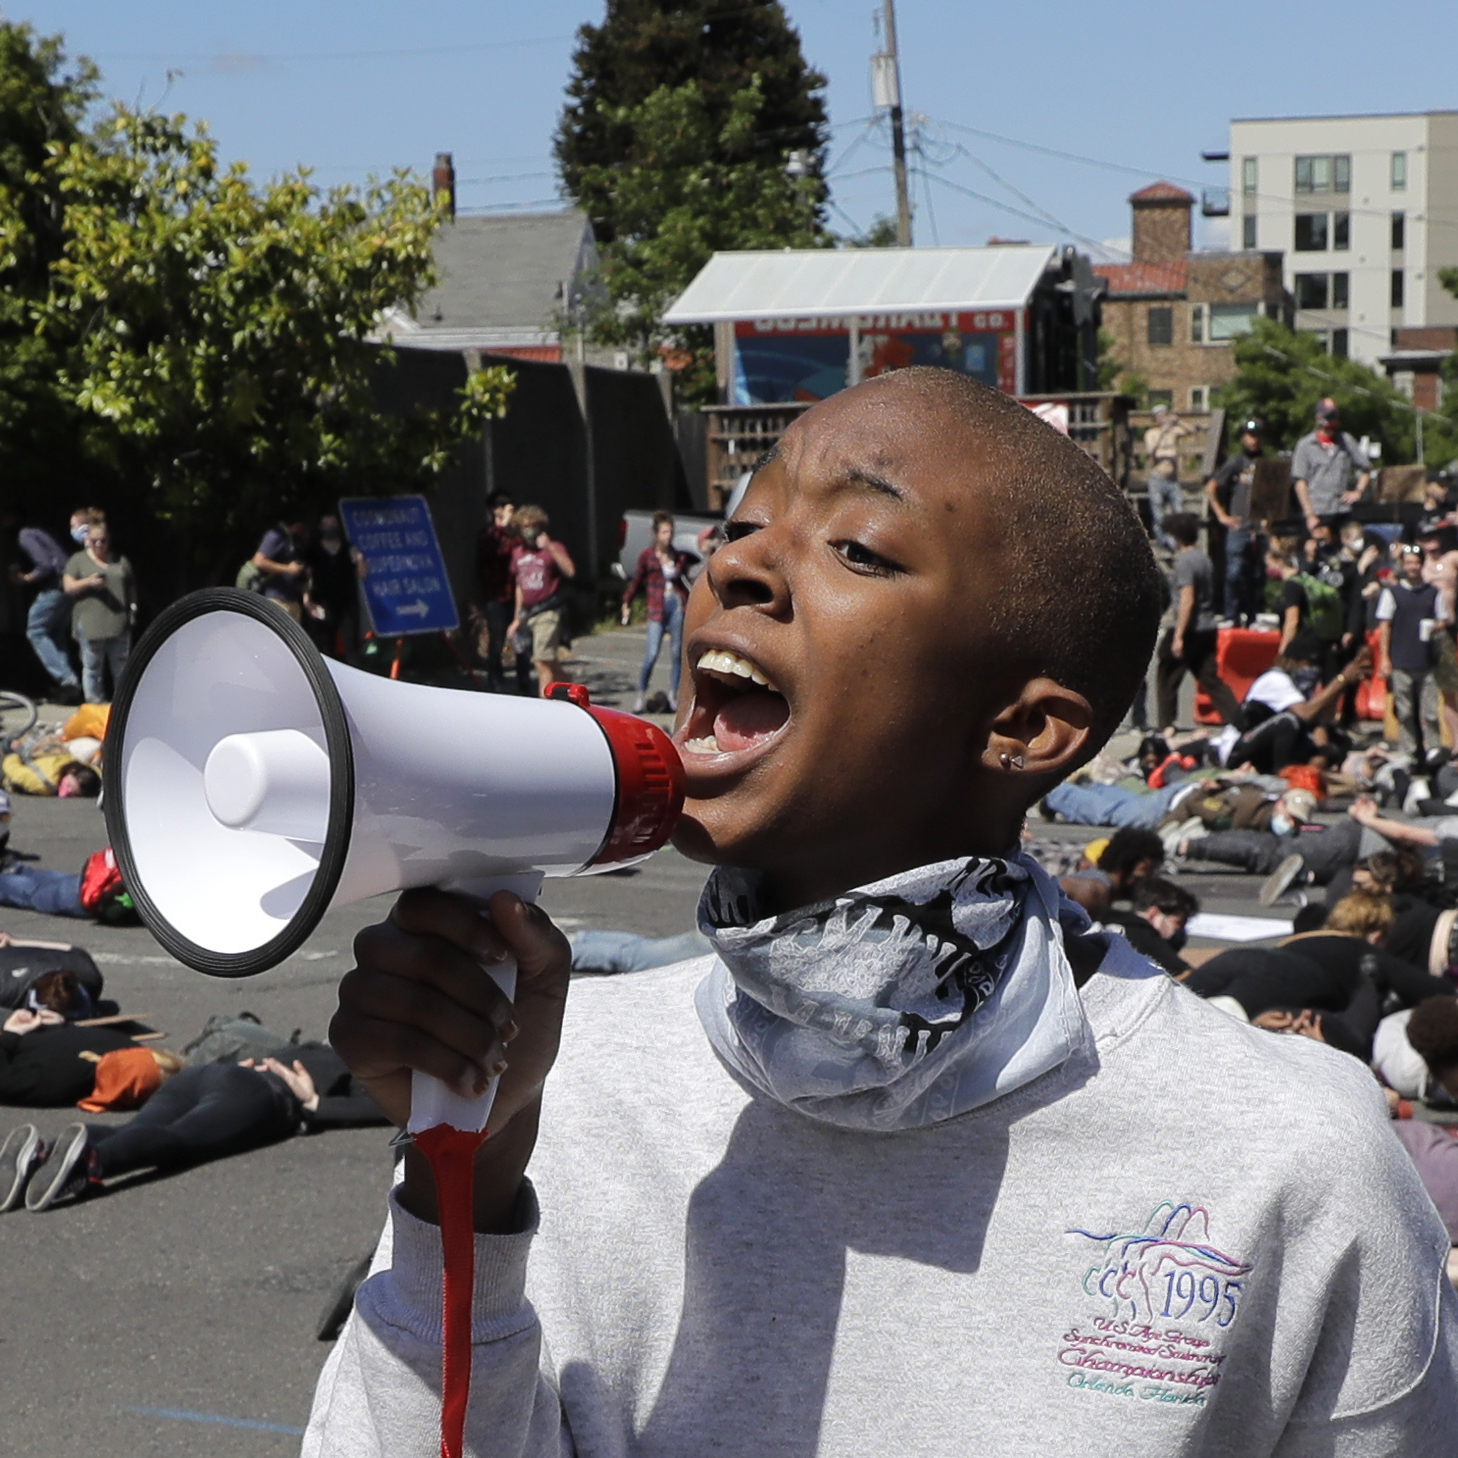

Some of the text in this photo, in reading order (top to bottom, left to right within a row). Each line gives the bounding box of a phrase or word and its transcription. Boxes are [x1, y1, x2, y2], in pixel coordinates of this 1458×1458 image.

[358, 529, 429, 551] COFFEE AND
[1160, 1269, 1242, 1327] 1995
[1127, 1325, 1163, 1343] Age
[1161, 1328, 1211, 1349] Group
[1057, 1347, 1221, 1389] Championships
[1067, 1372, 1206, 1408] Orlando Florida
